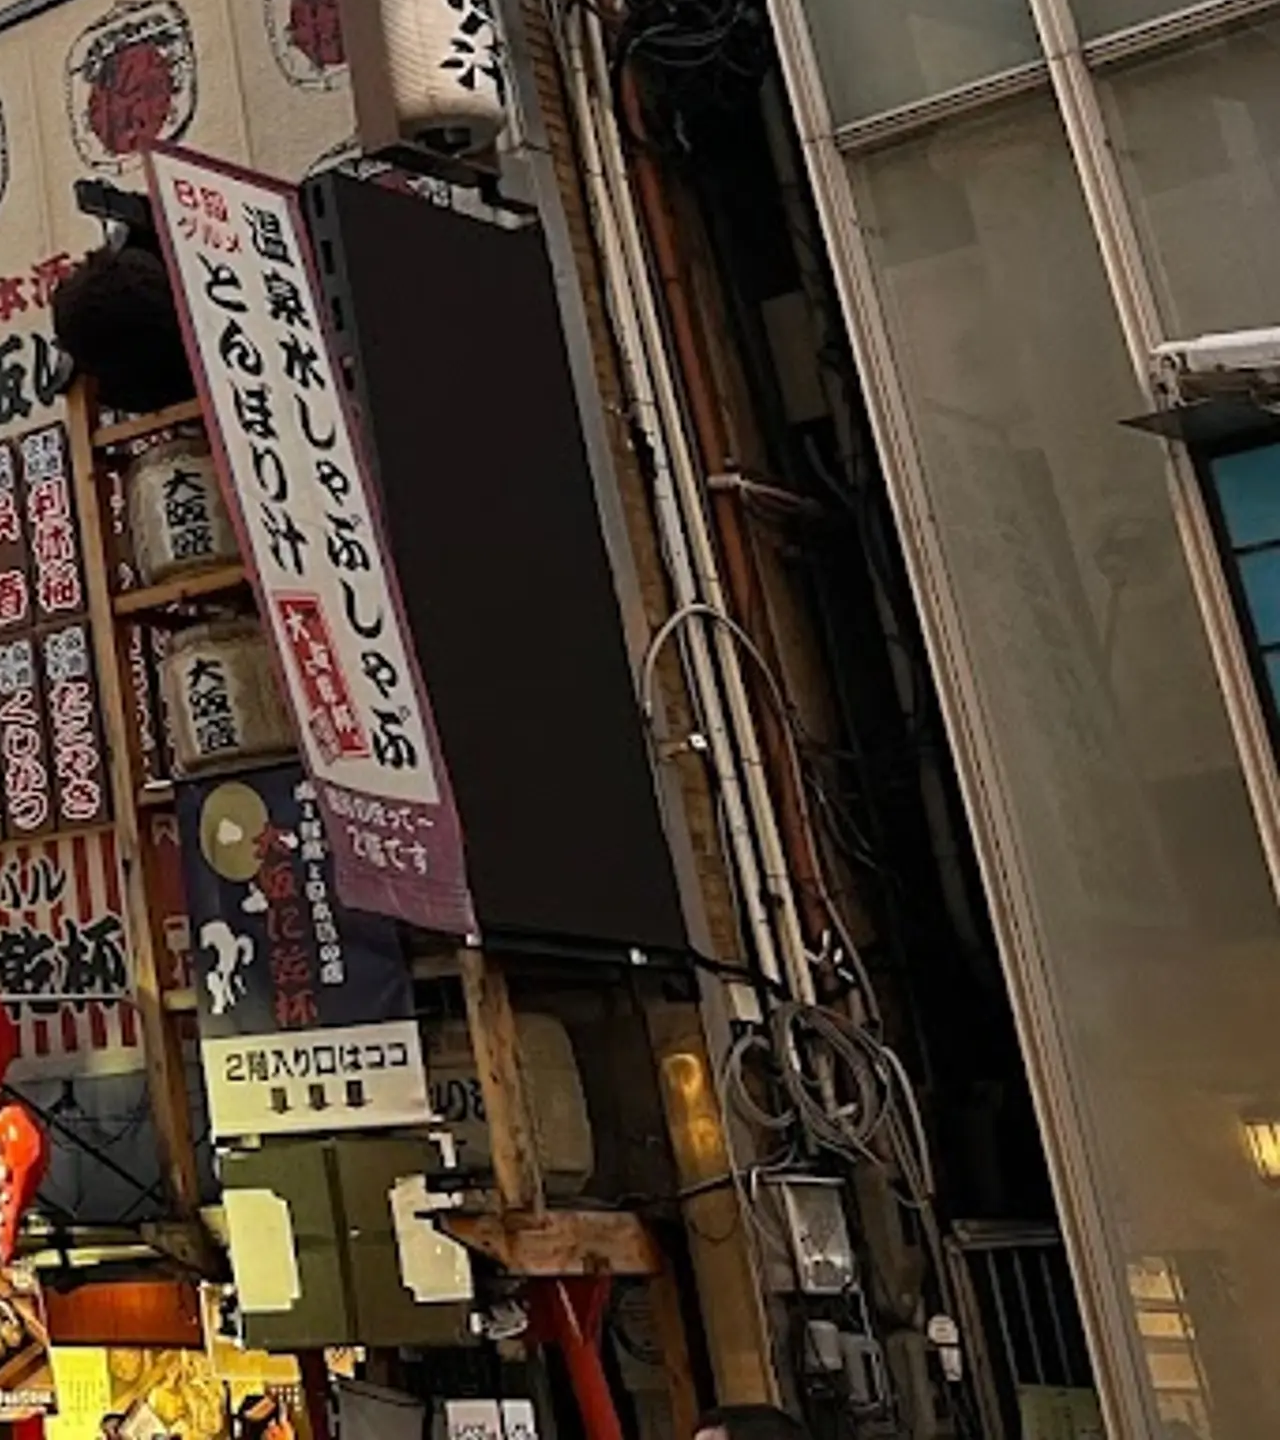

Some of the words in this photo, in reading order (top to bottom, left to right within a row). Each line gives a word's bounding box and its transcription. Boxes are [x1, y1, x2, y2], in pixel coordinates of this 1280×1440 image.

[225, 1042, 409, 1082] 2階入り口はココ
